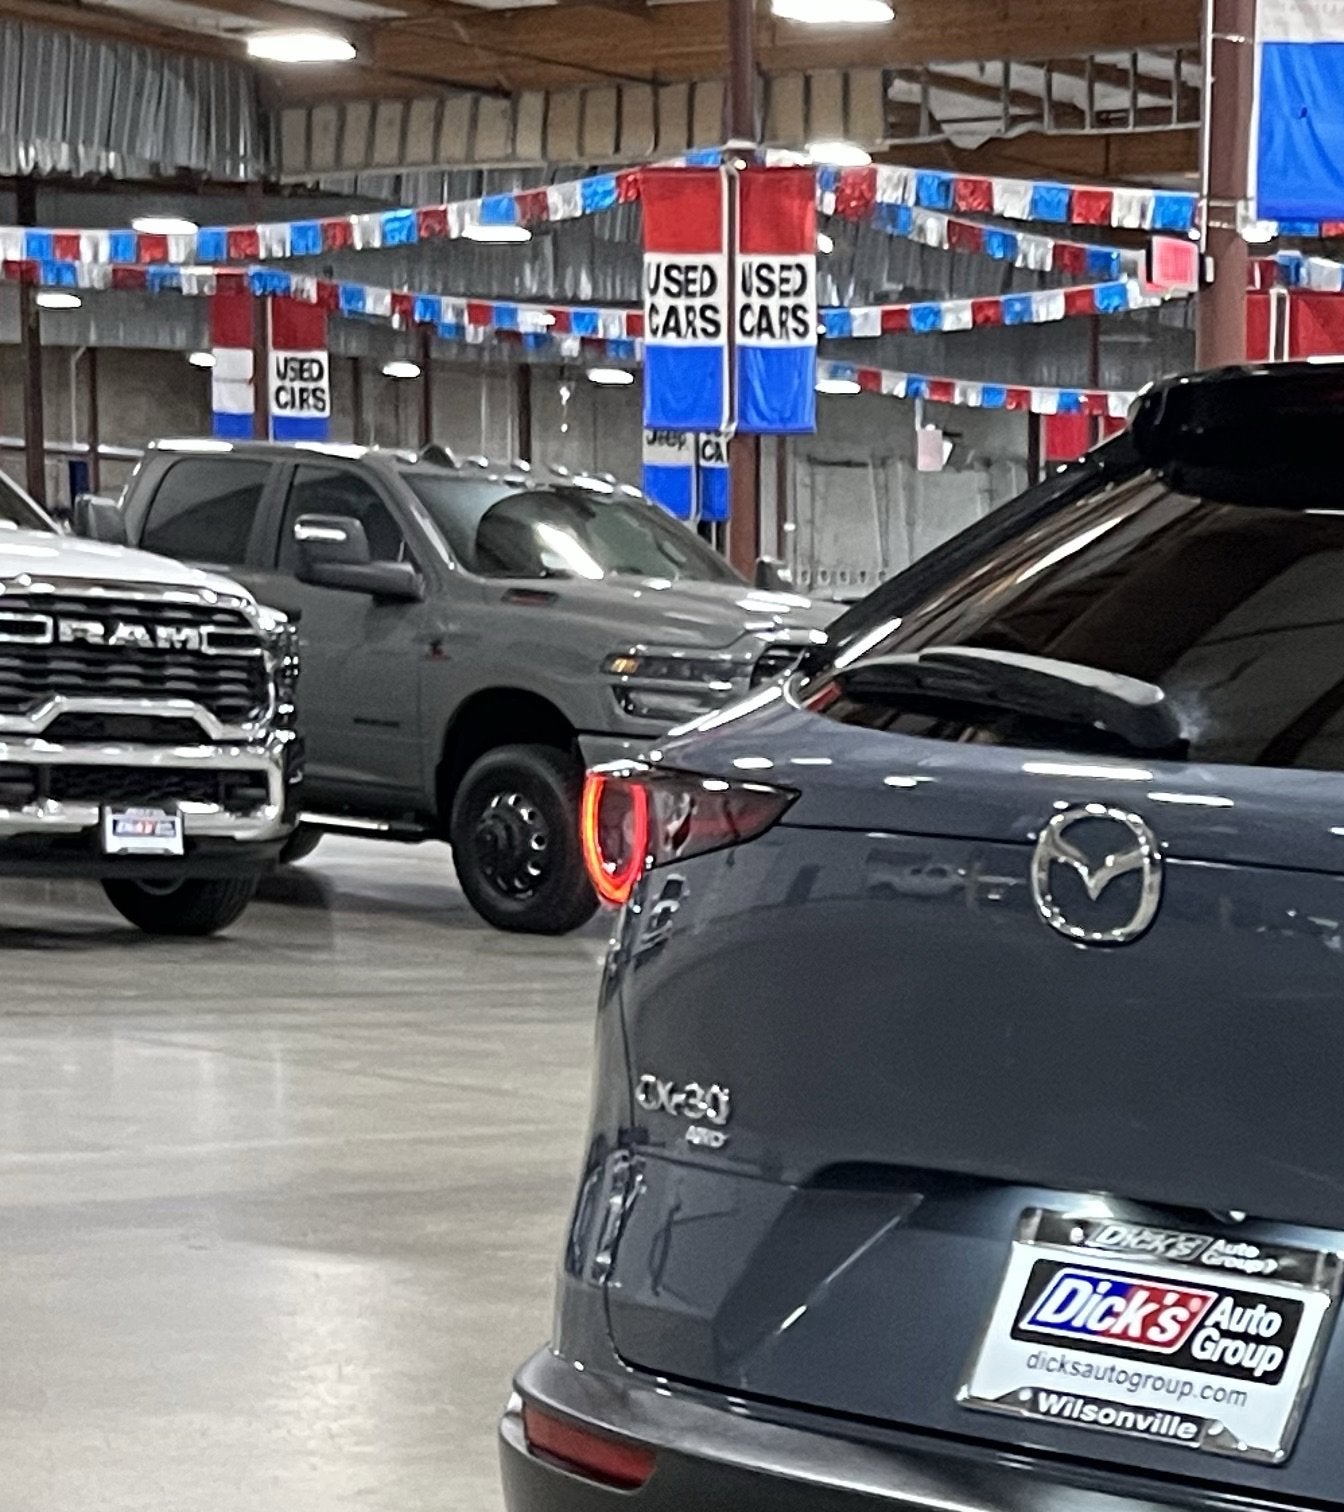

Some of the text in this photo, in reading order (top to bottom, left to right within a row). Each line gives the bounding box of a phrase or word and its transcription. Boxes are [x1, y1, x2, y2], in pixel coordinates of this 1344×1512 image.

[648, 263, 717, 298] USED
[742, 262, 807, 298] USED
[649, 303, 721, 339] CARS
[739, 303, 809, 340] CARS
[275, 356, 324, 382] USED
[57, 620, 200, 650] RAM
[1035, 1278, 1283, 1344] Dick's Auto
[1191, 1329, 1285, 1378] Group
[1026, 1350, 1248, 1408] dicksautogroup.com
[1037, 1390, 1199, 1441] Wilsonville
